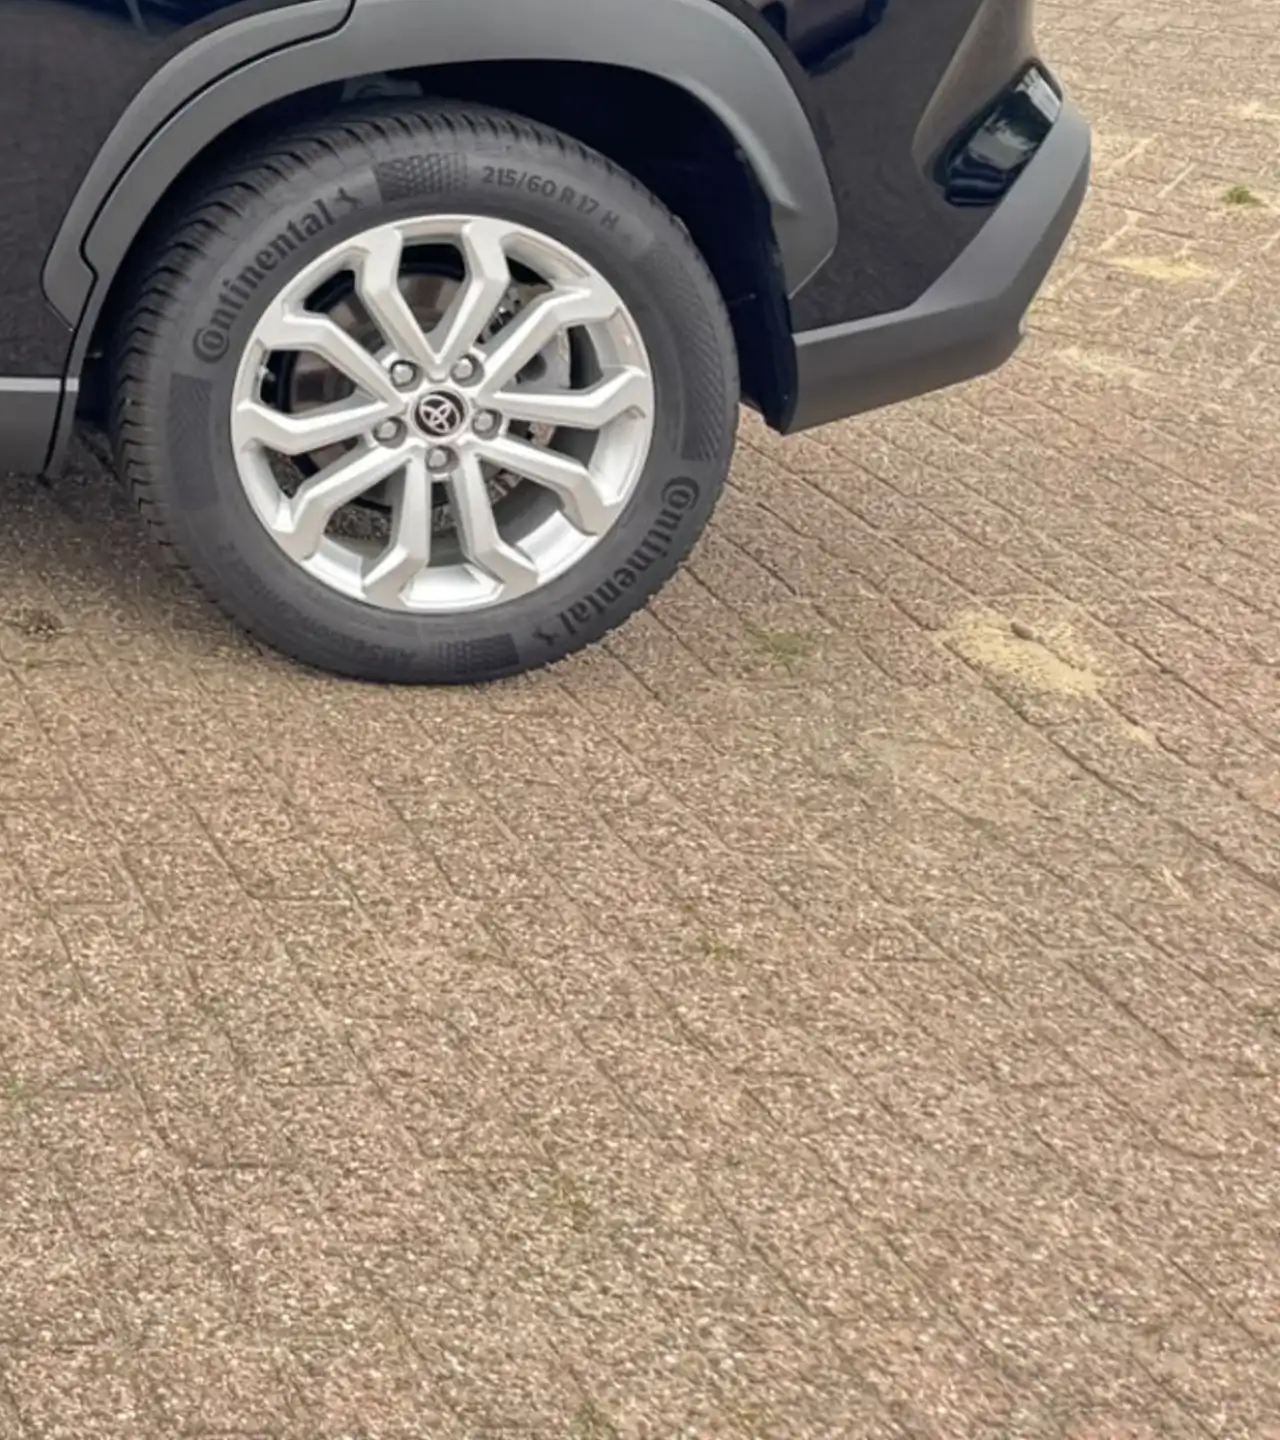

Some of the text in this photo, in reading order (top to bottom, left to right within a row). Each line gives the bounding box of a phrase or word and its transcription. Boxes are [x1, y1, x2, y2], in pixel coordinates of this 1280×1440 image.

[482, 164, 557, 199] 215/60
[559, 185, 576, 206] R
[192, 197, 336, 364] Continental
[557, 475, 700, 636] Continental
